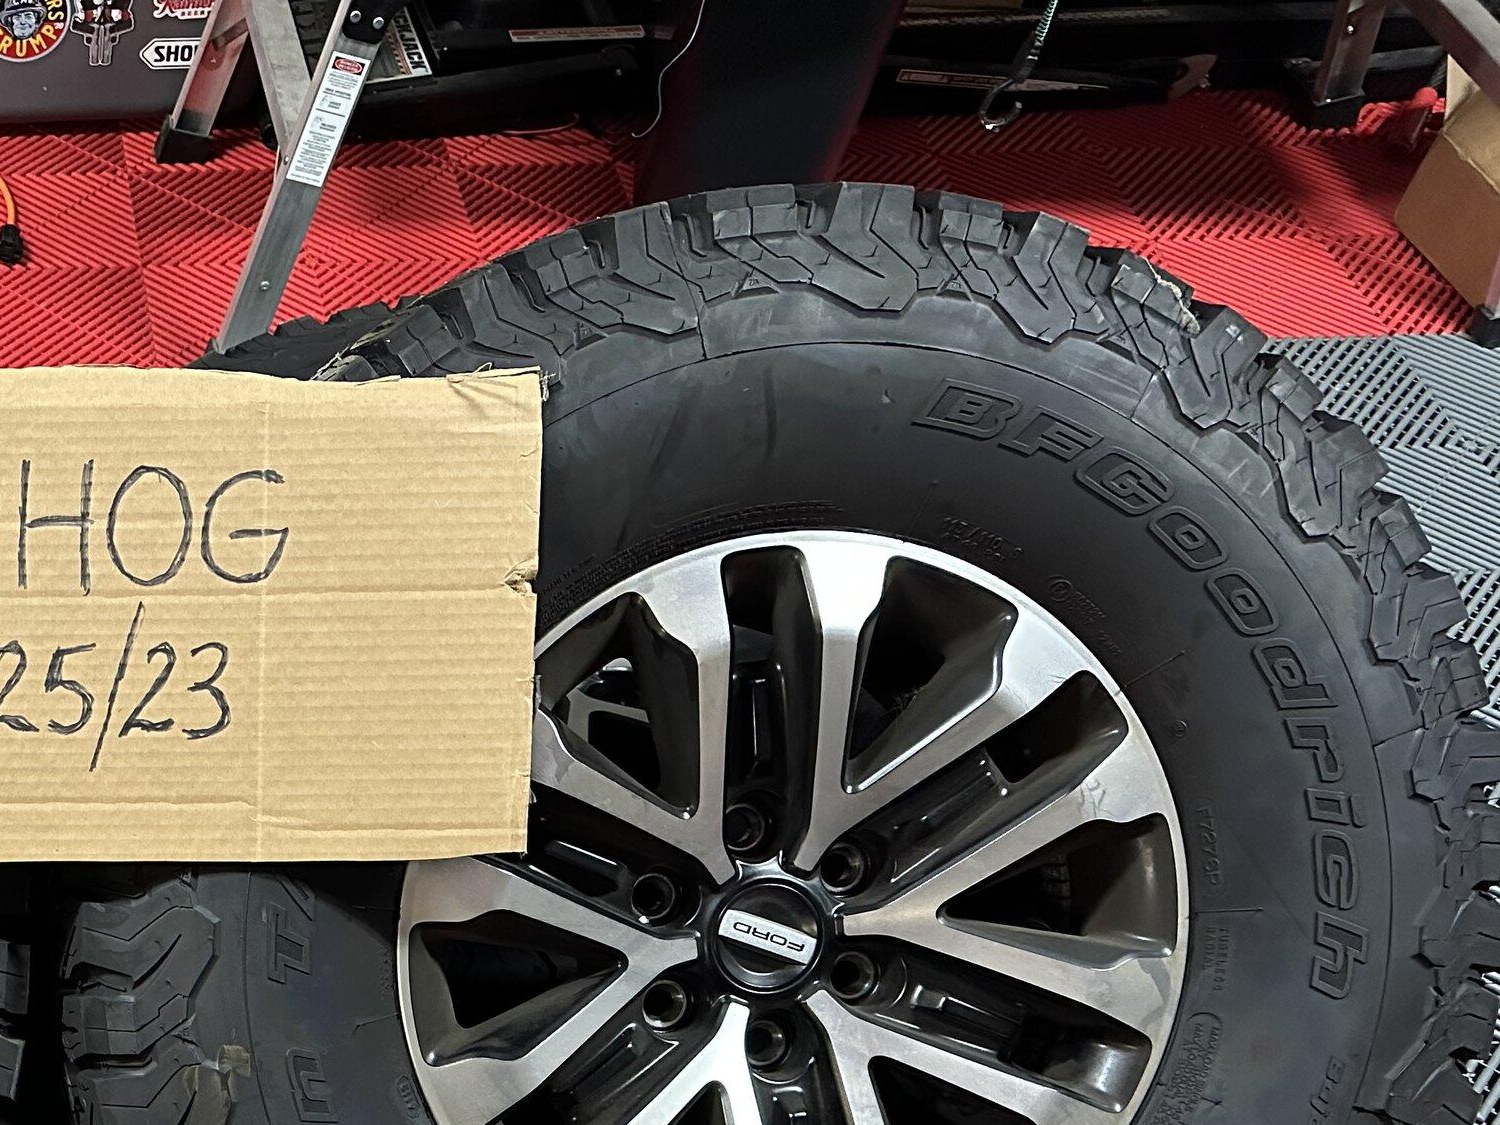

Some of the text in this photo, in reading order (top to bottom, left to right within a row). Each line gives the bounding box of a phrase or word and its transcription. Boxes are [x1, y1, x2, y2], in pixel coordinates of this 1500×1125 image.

[910, 378, 1369, 1000] BFGoodrich
[733, 921, 805, 952] FORD
[1203, 927, 1215, 972] RADIAL
